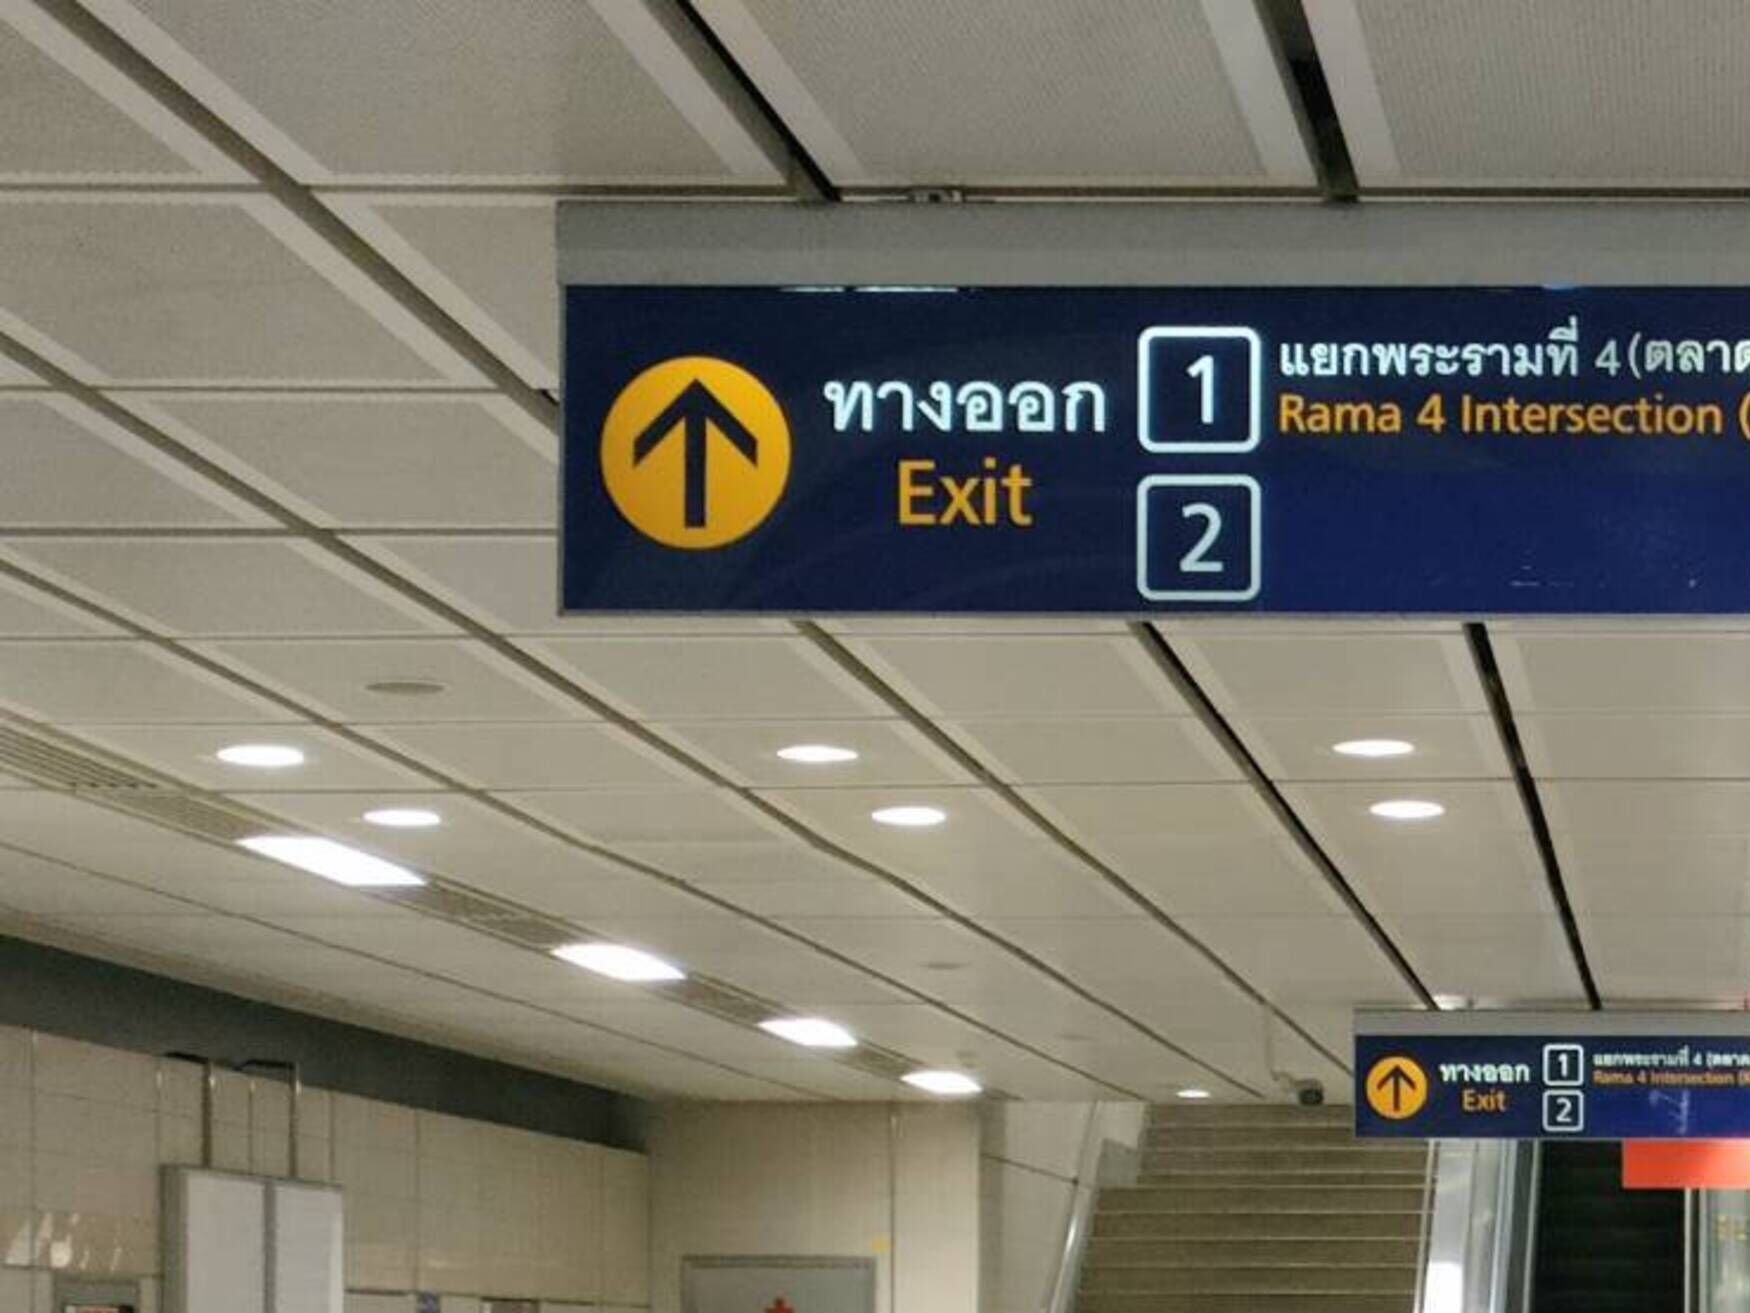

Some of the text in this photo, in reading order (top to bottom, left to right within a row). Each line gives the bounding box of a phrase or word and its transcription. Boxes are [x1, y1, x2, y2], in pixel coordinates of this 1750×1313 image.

[1279, 327, 1580, 378] แยกพระรามที่
[822, 379, 1107, 434] ทางออก
[1186, 353, 1215, 425] 1
[1278, 395, 1402, 432] Rama
[1416, 395, 1447, 432] 4
[1461, 395, 1723, 433] Intersection
[897, 457, 1034, 527] Exit
[1178, 501, 1224, 573] 2
[1439, 1062, 1530, 1084] ทางออก
[1557, 1052, 1570, 1078] 1
[1462, 1088, 1507, 1112] Exit
[1555, 1098, 1573, 1122] 2
